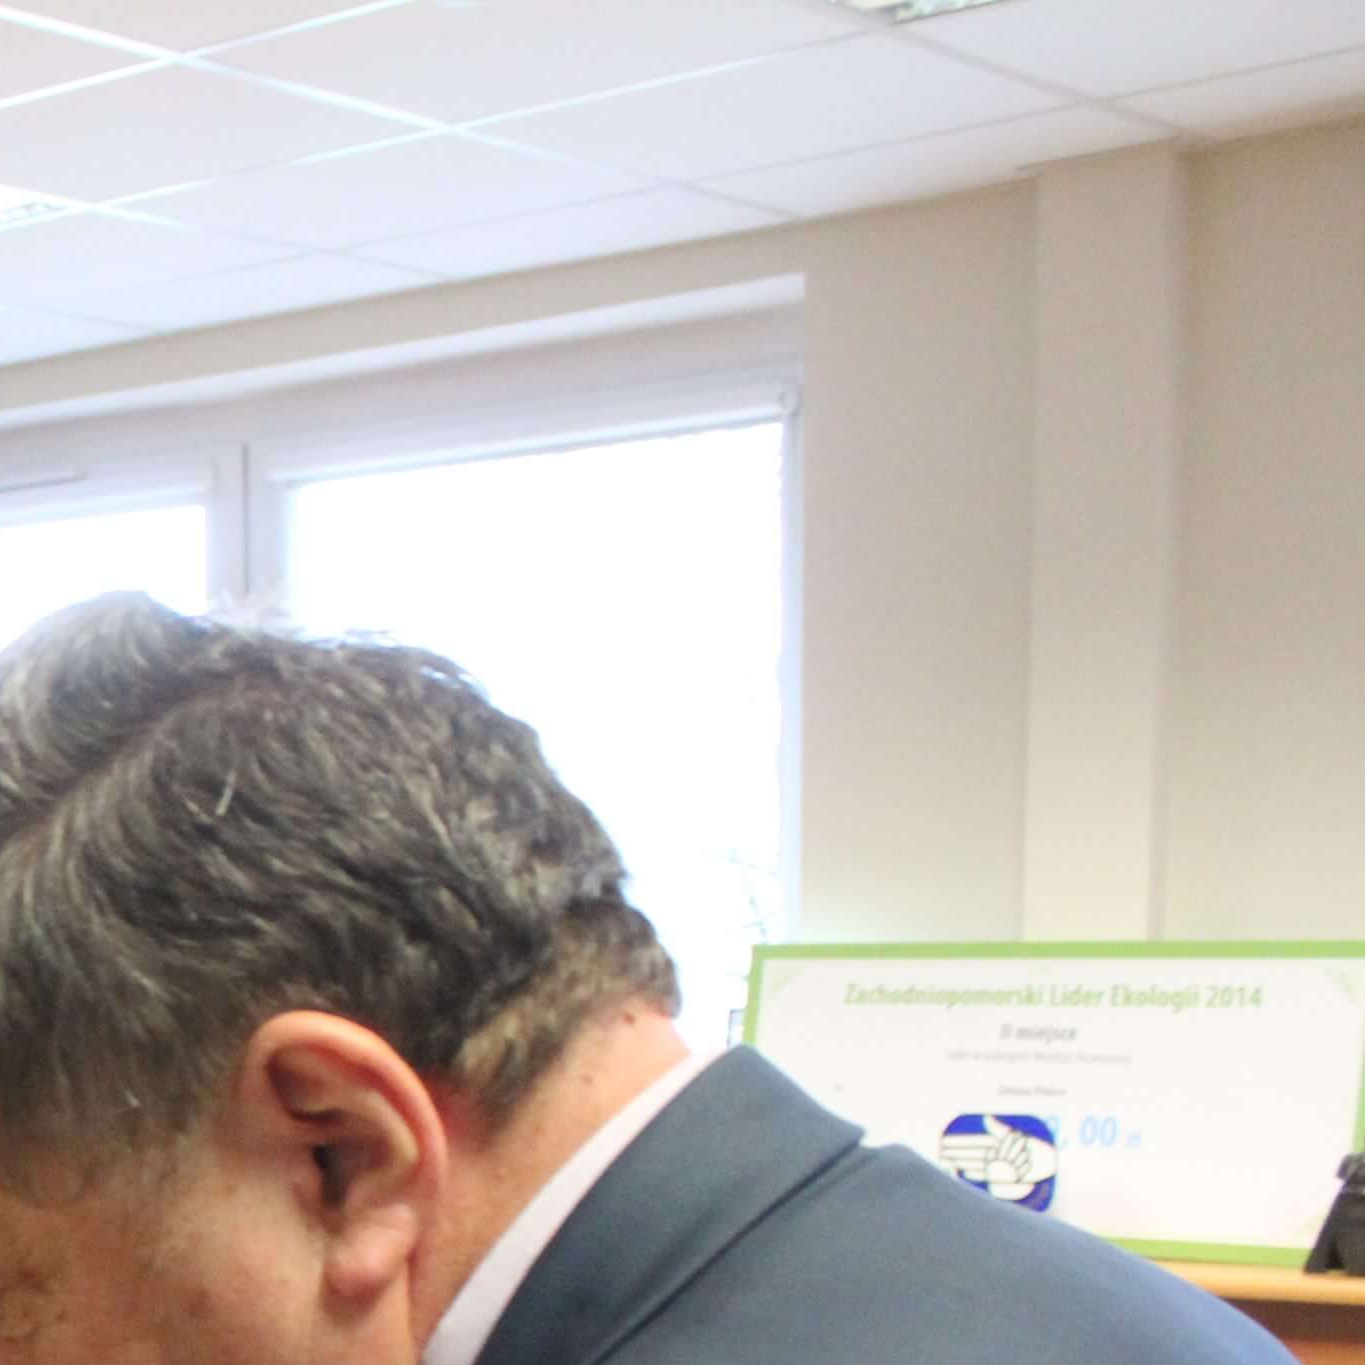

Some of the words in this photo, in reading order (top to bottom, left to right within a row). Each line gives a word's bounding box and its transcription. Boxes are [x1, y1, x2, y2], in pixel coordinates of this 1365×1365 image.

[844, 982, 1044, 1014] Zachodniopomorski
[1049, 983, 1106, 1008] Lider
[1109, 983, 1200, 1015] Ekologii
[1204, 984, 1264, 1009] 2014
[1014, 1023, 1078, 1047] miejsce
